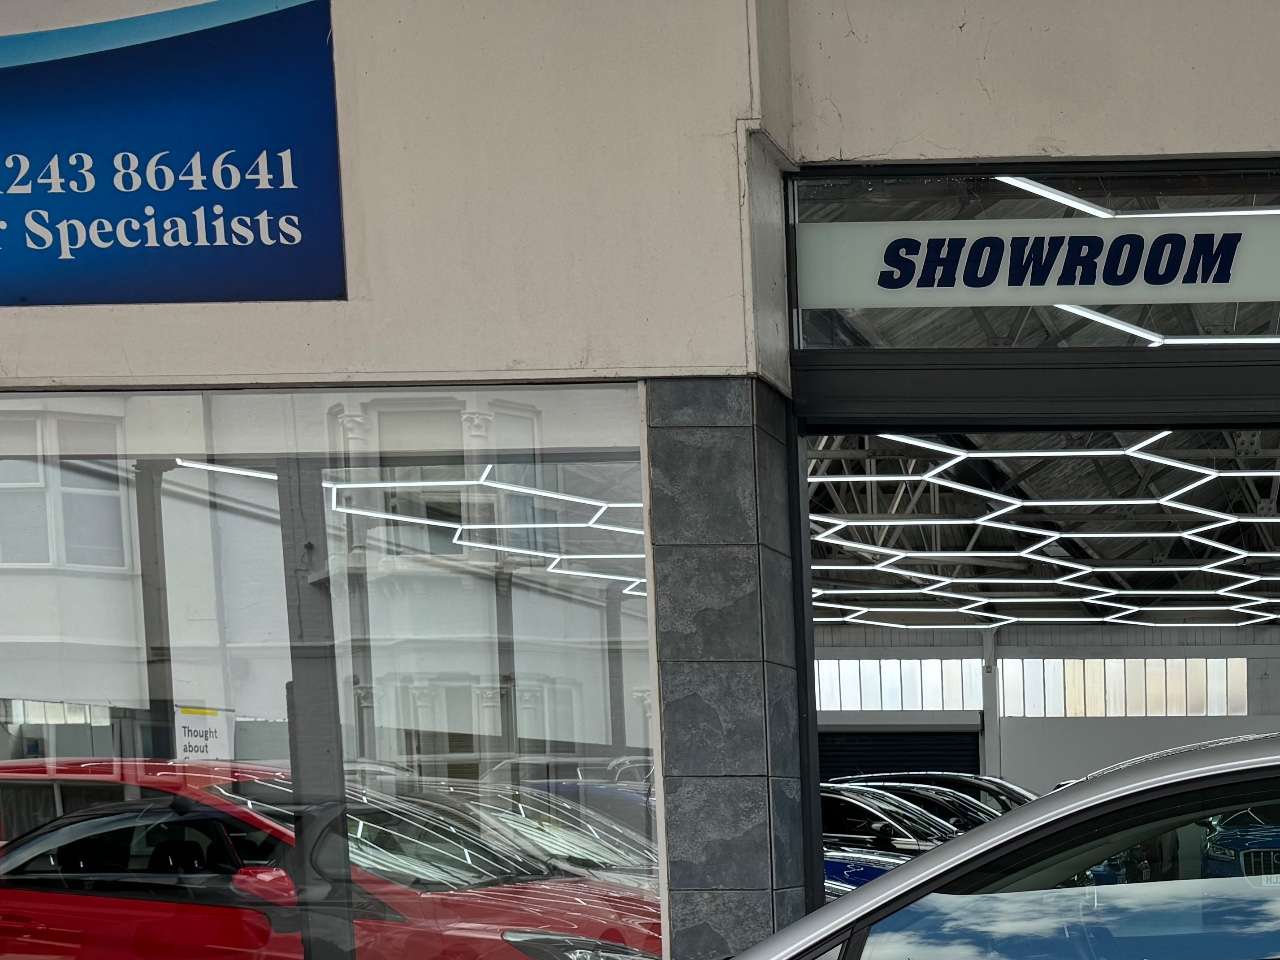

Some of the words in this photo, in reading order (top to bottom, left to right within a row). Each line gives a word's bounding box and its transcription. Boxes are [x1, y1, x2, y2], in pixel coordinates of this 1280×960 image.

[113, 149, 299, 193] 864641
[24, 204, 302, 259] Specialists
[877, 233, 1243, 289] SHOWROOM
[181, 726, 218, 741] Thought
[183, 741, 208, 754] about
